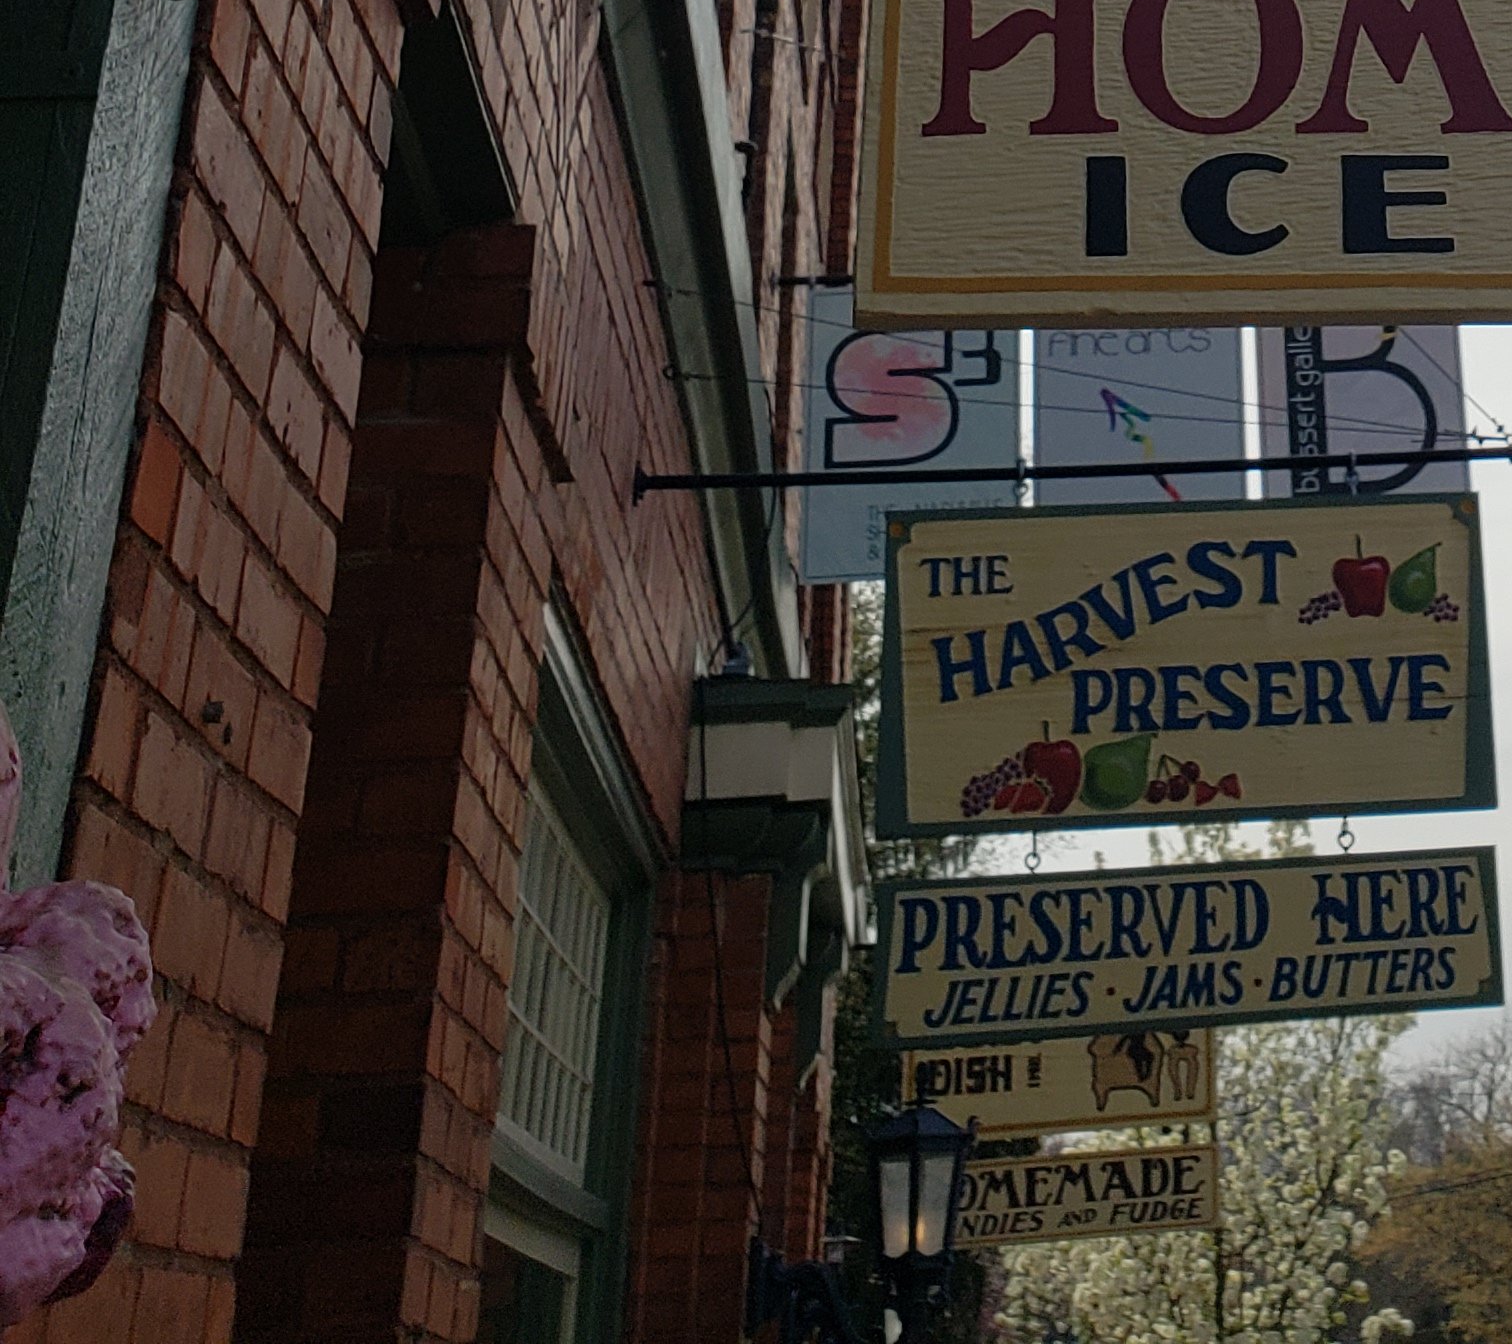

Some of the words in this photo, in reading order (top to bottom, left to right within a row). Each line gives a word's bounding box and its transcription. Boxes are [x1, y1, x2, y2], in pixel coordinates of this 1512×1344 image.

[1085, 152, 1455, 257] ICE
[919, 555, 1014, 598] THE
[930, 539, 1299, 704] HARVEST
[1070, 654, 1455, 736] PRESERVE
[894, 877, 1270, 974] PRESERVED
[1311, 864, 1480, 945] HERE
[923, 971, 1095, 1029] JELLIES
[1122, 960, 1244, 1014] JAMS
[1268, 947, 1458, 1002] BUTTERS
[927, 1054, 1013, 1096] DISH
[1057, 1207, 1098, 1229] AND
[1109, 1196, 1206, 1224] FUDGE
